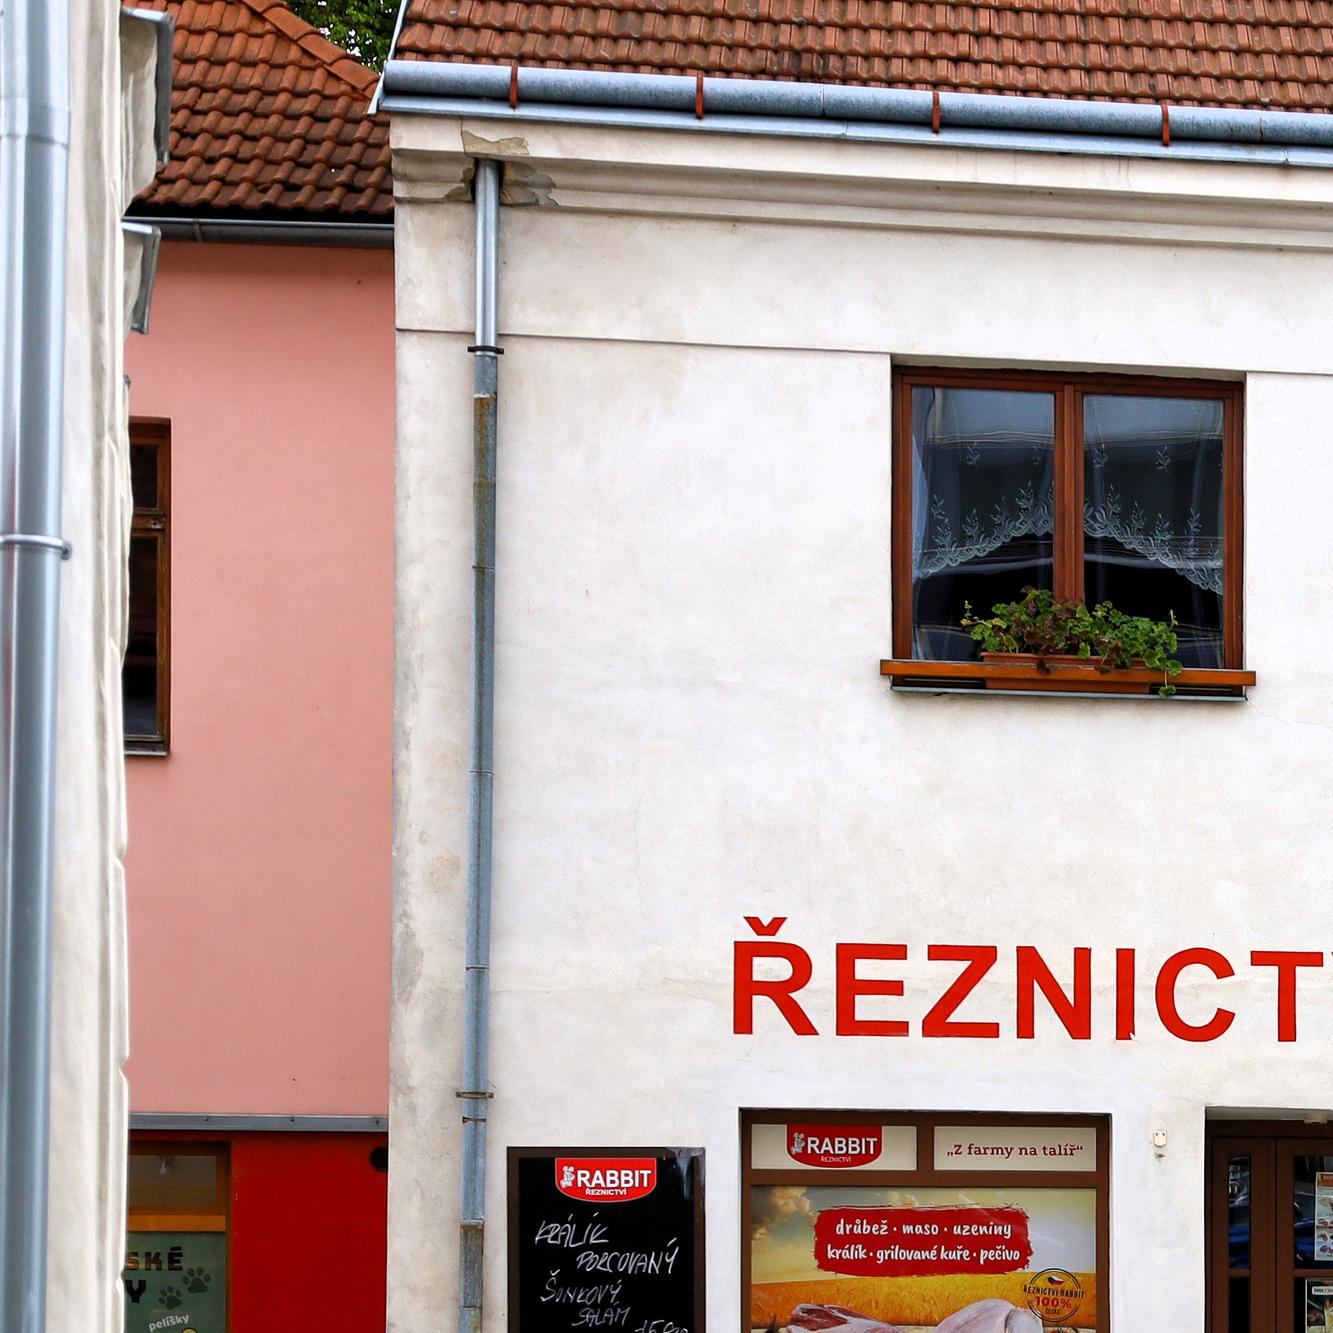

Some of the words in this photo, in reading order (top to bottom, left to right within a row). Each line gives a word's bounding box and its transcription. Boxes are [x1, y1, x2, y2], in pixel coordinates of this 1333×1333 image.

[807, 1136, 877, 1155] RABBIT
[967, 1143, 1014, 1160] farmy
[1018, 1146, 1038, 1156] na
[577, 1169, 652, 1188] RABBIT
[585, 1187, 627, 1196] ŘEZNICTVÍ
[535, 1212, 609, 1248] KRÁLÍK
[835, 1218, 889, 1235] drůbež
[902, 1223, 939, 1235] maso
[953, 1221, 1012, 1239] uzeniny
[576, 1237, 680, 1274] PORCOVANÝ
[826, 1243, 868, 1260] králík
[876, 1245, 939, 1264] grilované
[940, 1246, 971, 1261] kuře
[980, 1246, 1020, 1264] pečivo
[1035, 1296, 1072, 1309] 100%
[148, 1313, 190, 1333] pelíšky
[571, 1301, 631, 1327] SALÁM
